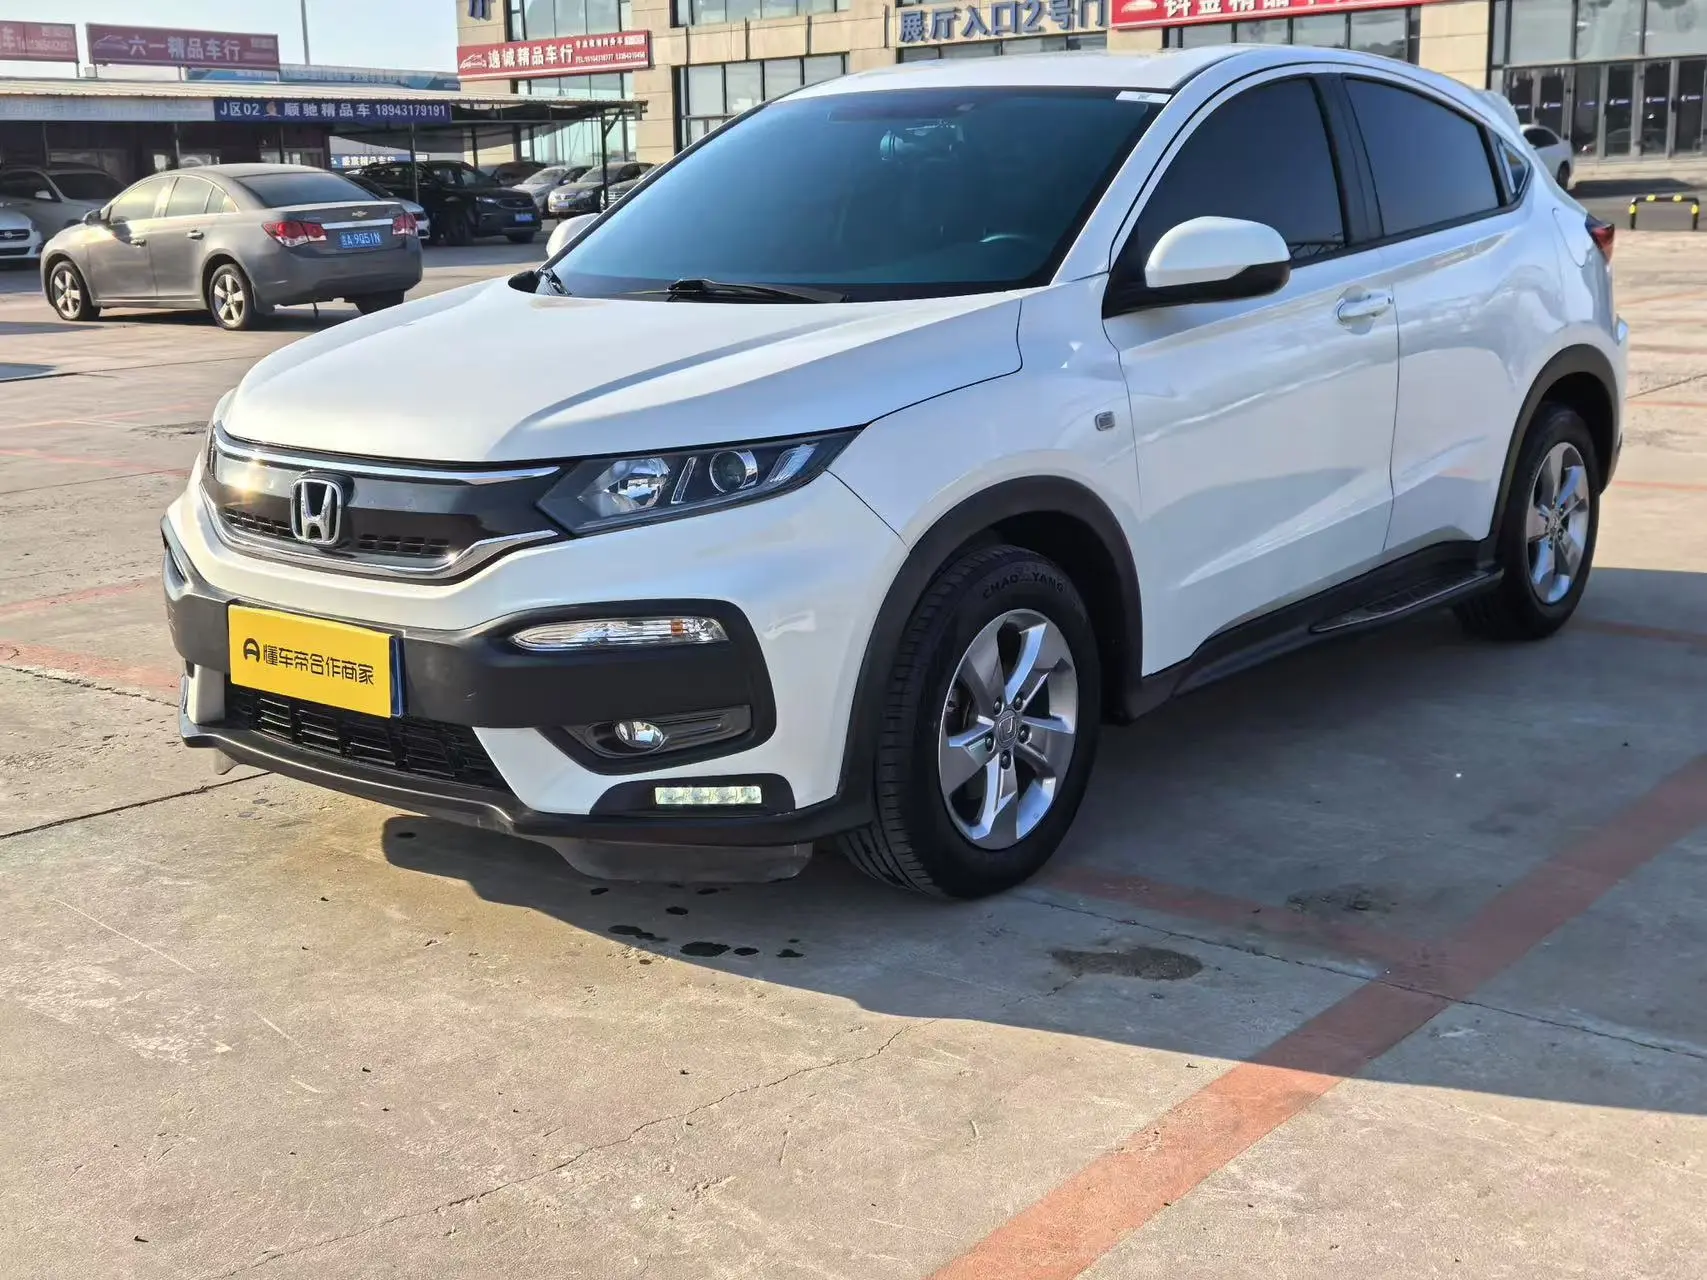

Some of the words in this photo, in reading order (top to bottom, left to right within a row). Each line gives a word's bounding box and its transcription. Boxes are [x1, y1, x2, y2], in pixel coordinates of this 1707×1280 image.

[901, 0, 1105, 42] 展厅入口2号门
[128, 35, 241, 61] 六一精品车行
[219, 101, 261, 117] J区02
[284, 102, 371, 117] 顺驰精品车
[375, 103, 446, 117] 18943179191
[263, 643, 375, 686] 懂车帝合作商家
